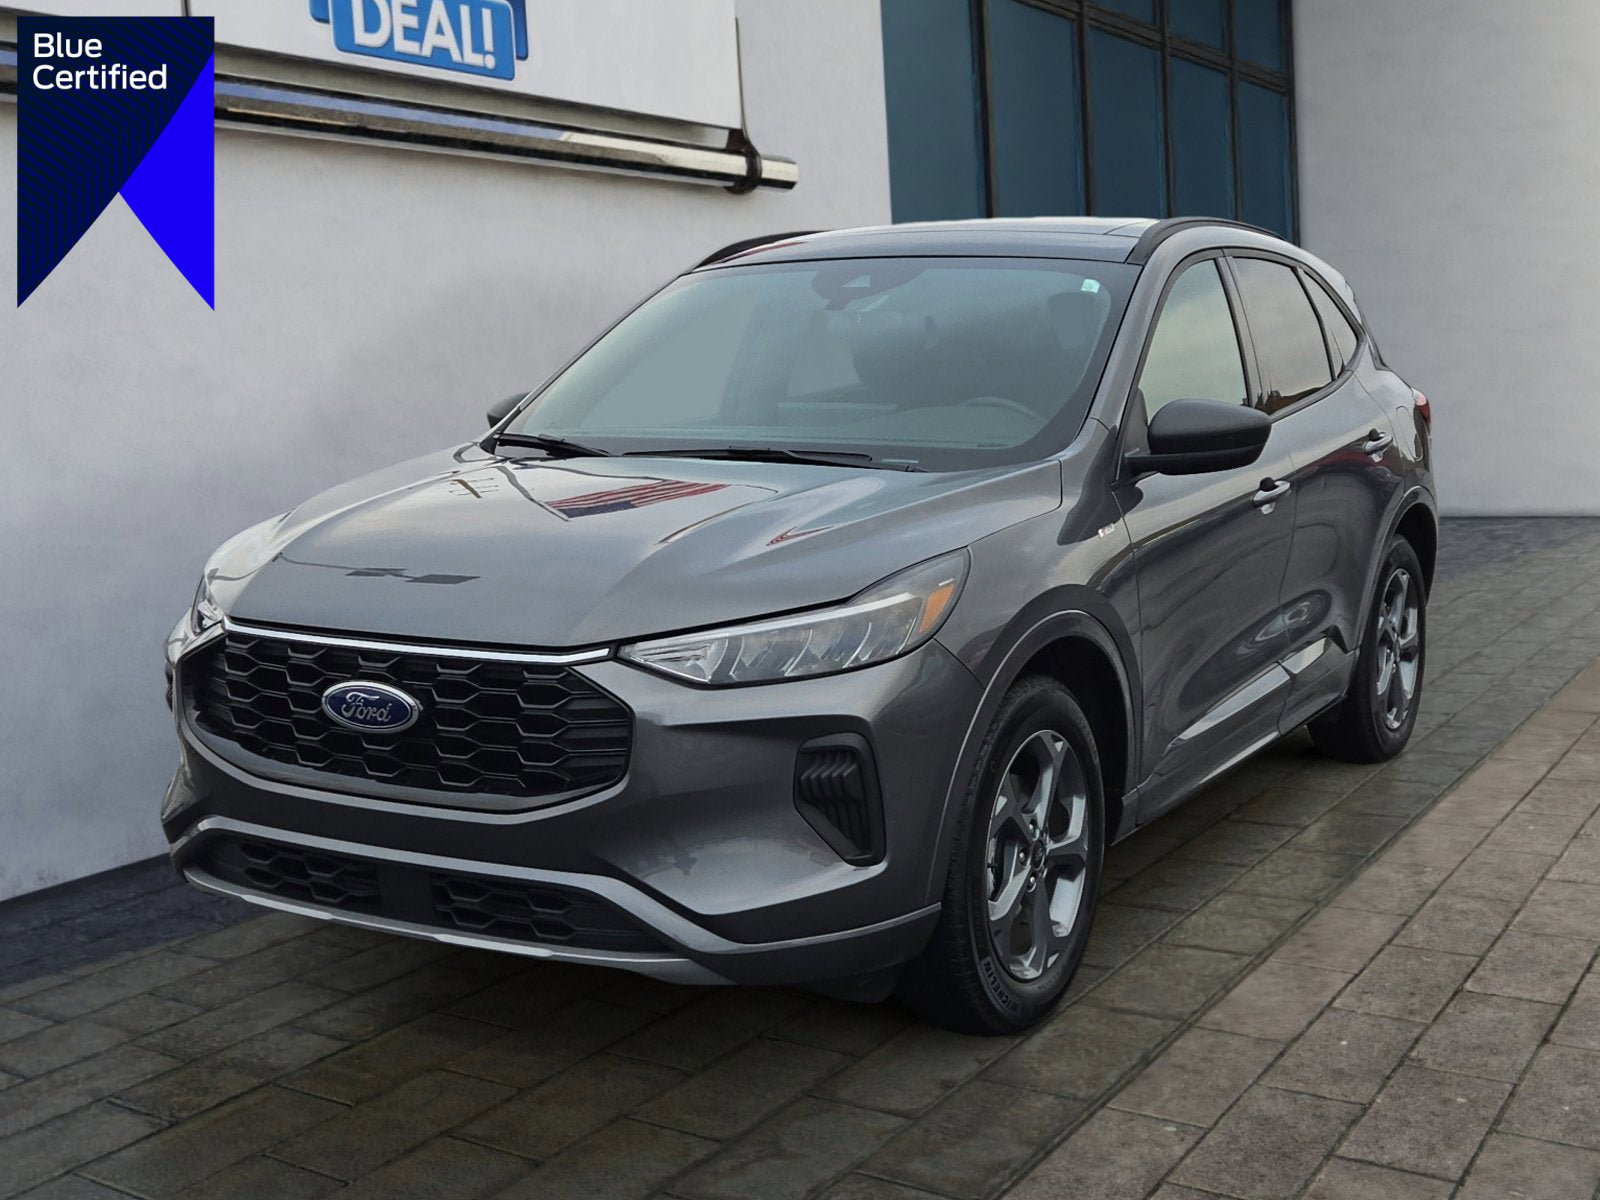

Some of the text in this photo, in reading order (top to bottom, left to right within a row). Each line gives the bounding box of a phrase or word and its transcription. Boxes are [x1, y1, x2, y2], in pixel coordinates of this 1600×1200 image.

[351, 0, 497, 70] DEAL!
[341, 691, 393, 723] Ford
[983, 960, 1020, 1013] MICHELIN
